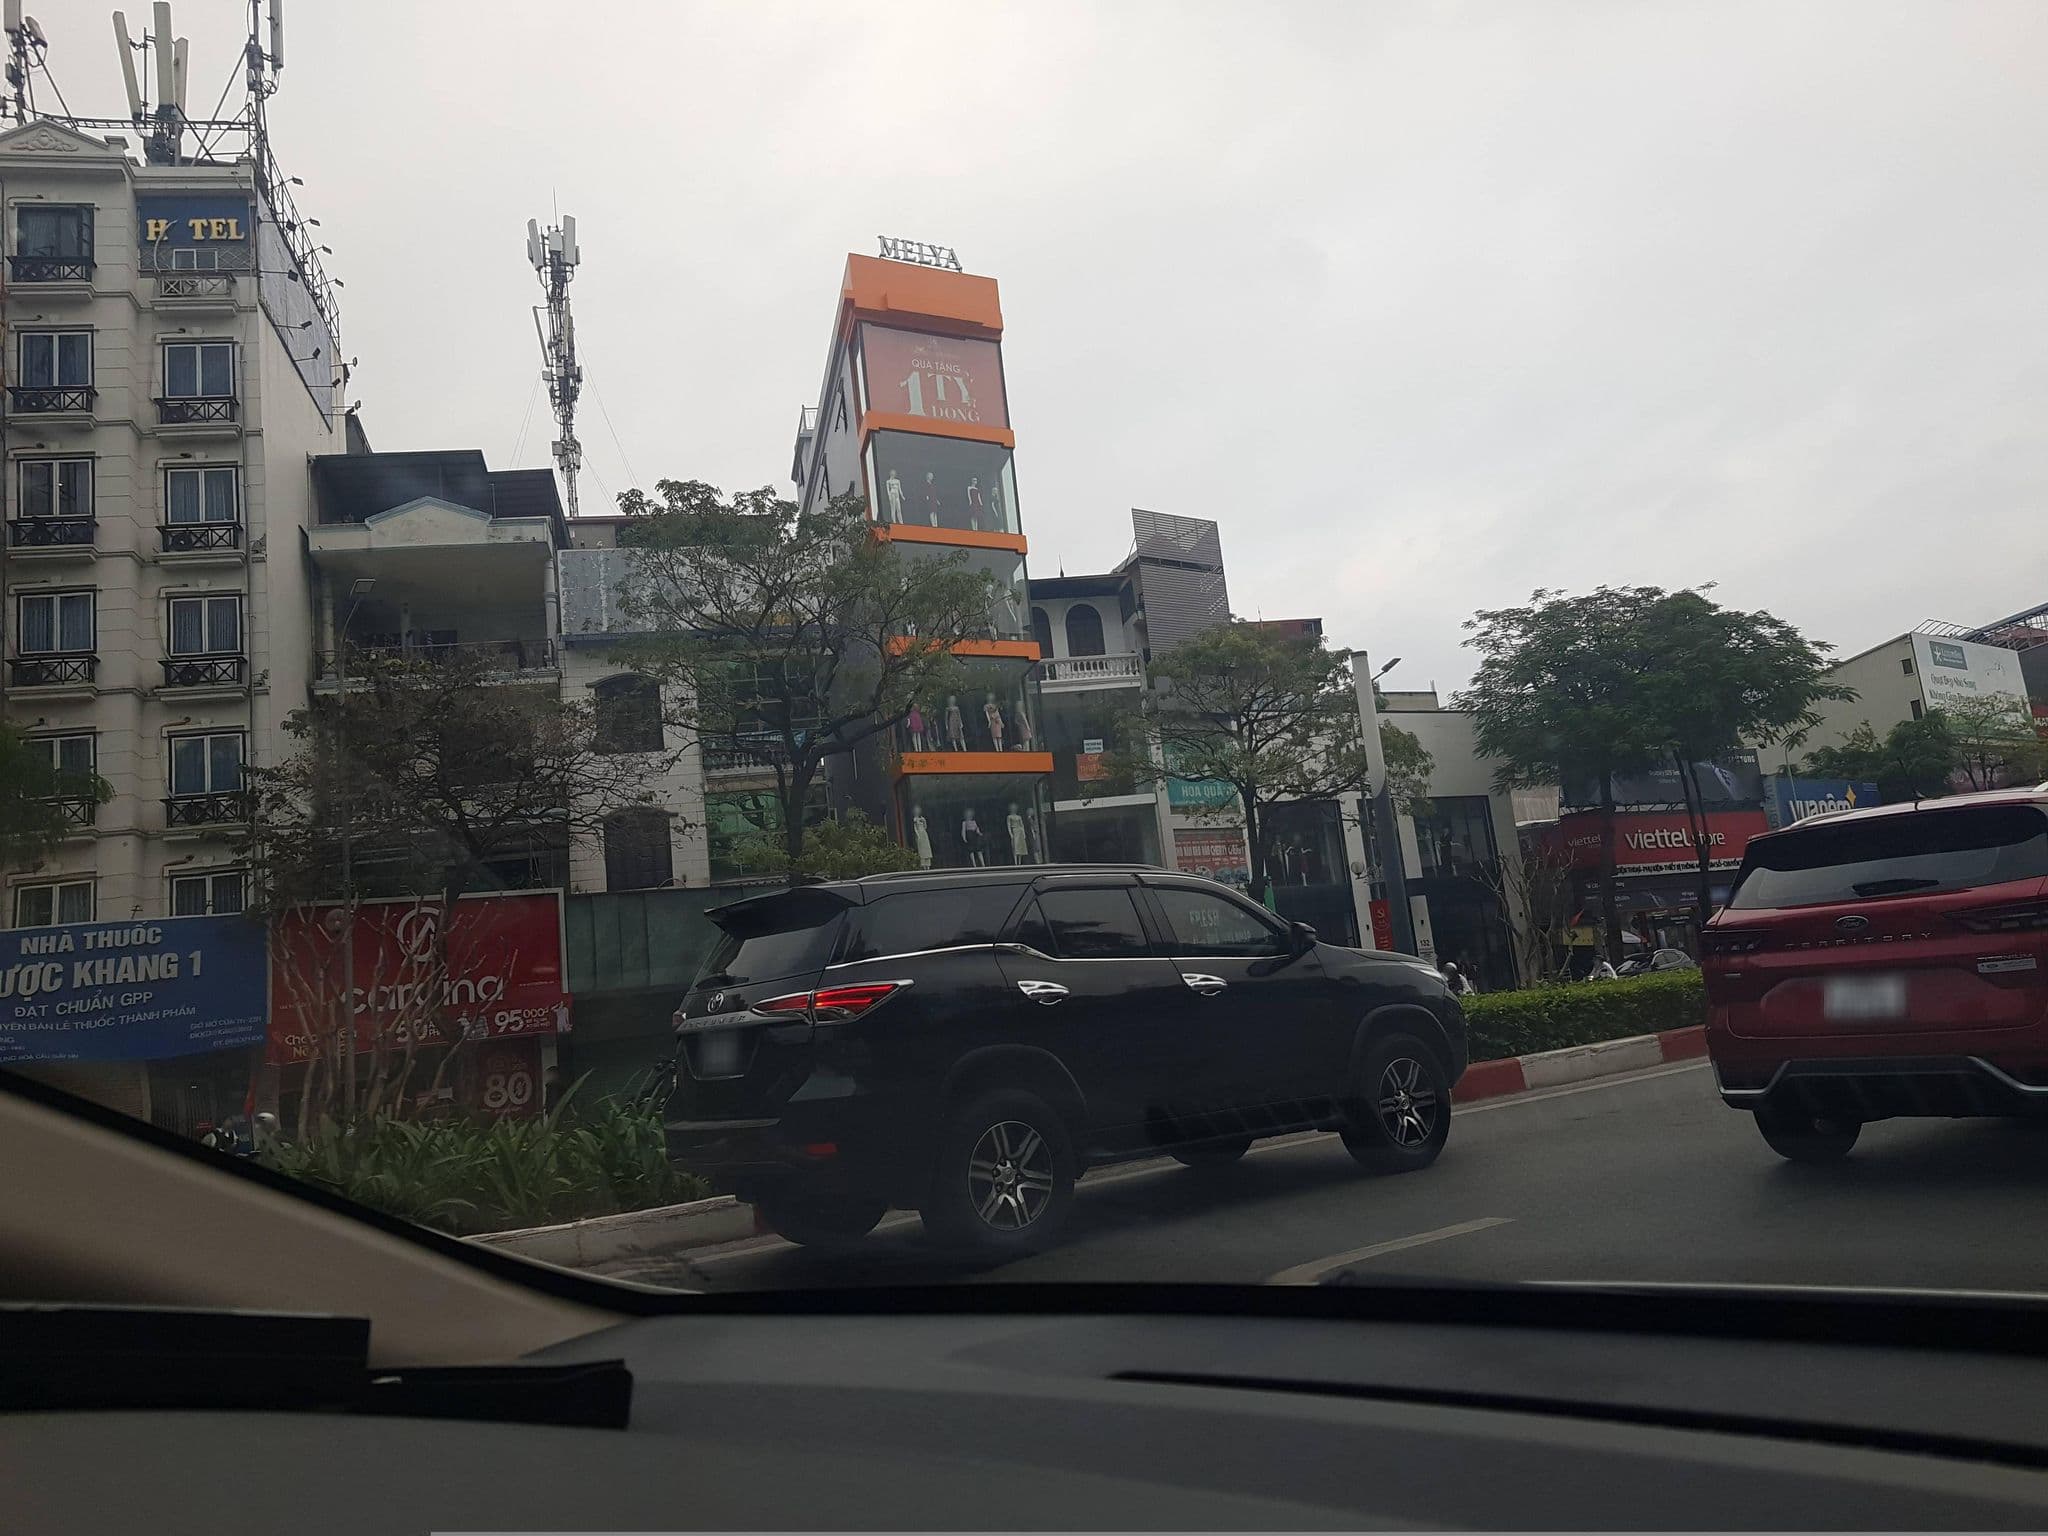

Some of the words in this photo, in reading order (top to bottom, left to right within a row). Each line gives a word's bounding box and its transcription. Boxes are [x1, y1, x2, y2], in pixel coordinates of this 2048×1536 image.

[877, 235, 962, 270] MELYA
[899, 370, 927, 416] 1
[1181, 785, 1201, 797] HOA
[1625, 828, 1691, 850] viettel
[21, 929, 75, 955] NHÀ
[83, 922, 162, 951] THUỐC
[72, 951, 179, 989] KHANG
[187, 950, 201, 977] 1
[14, 1004, 48, 1022] ĐẠT
[56, 989, 115, 1017] CHUẨN
[120, 990, 153, 1007] GPP
